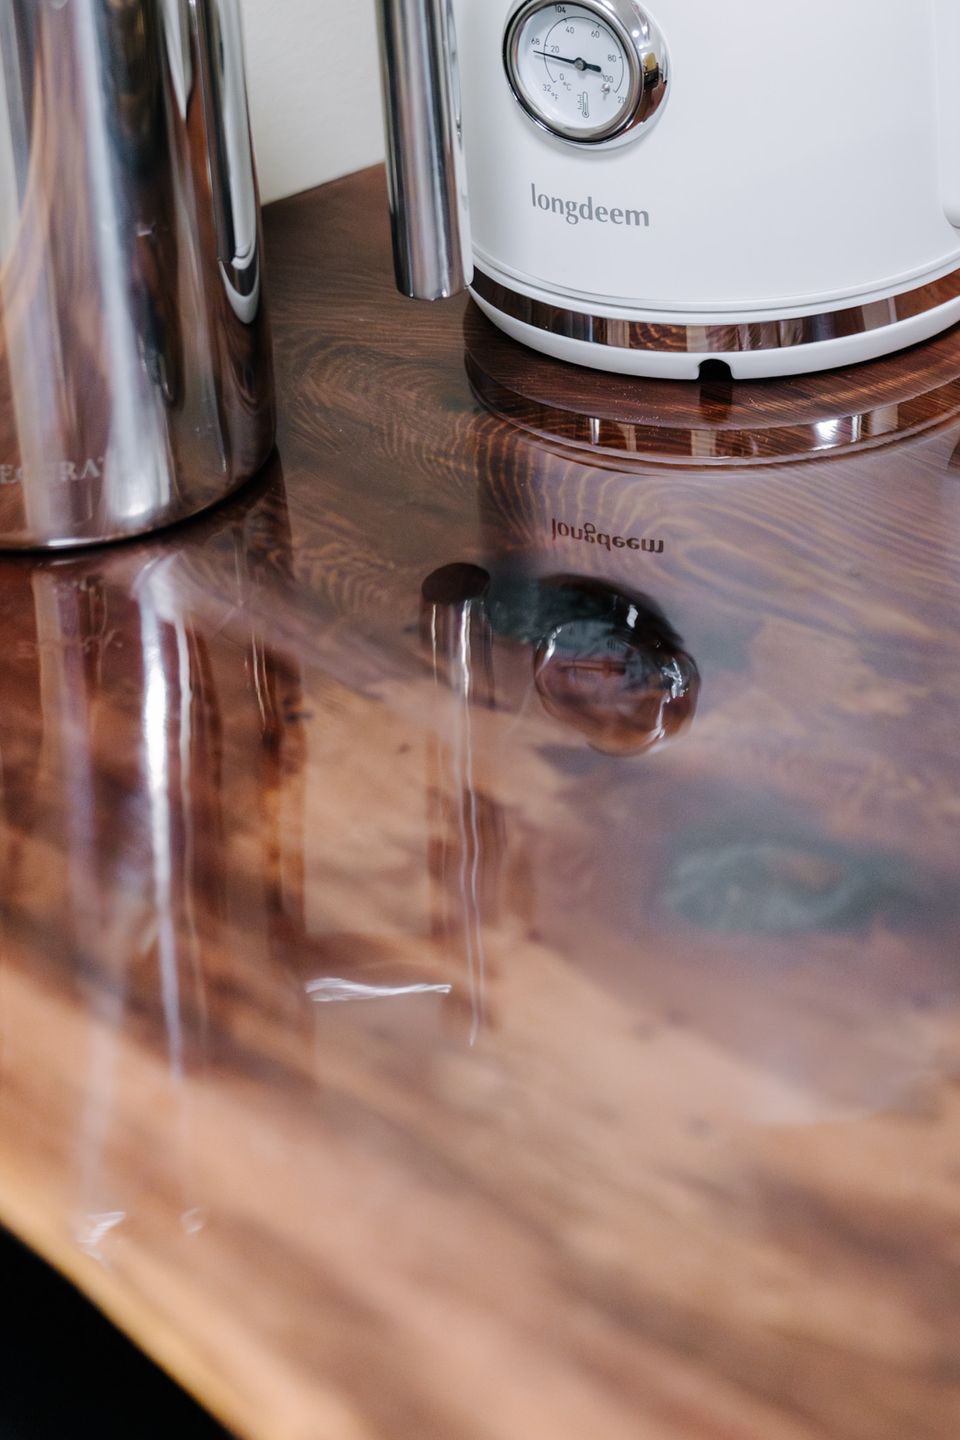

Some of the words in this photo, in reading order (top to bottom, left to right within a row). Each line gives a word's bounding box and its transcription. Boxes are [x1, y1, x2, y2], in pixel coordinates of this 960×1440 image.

[554, 5, 566, 13] 104
[565, 26, 575, 34] 40
[590, 30, 600, 38] 60
[551, 45, 559, 53] 20
[607, 54, 617, 62] 80
[602, 73, 613, 82] 100
[543, 83, 551, 92] 32
[530, 182, 650, 227] longdeem
